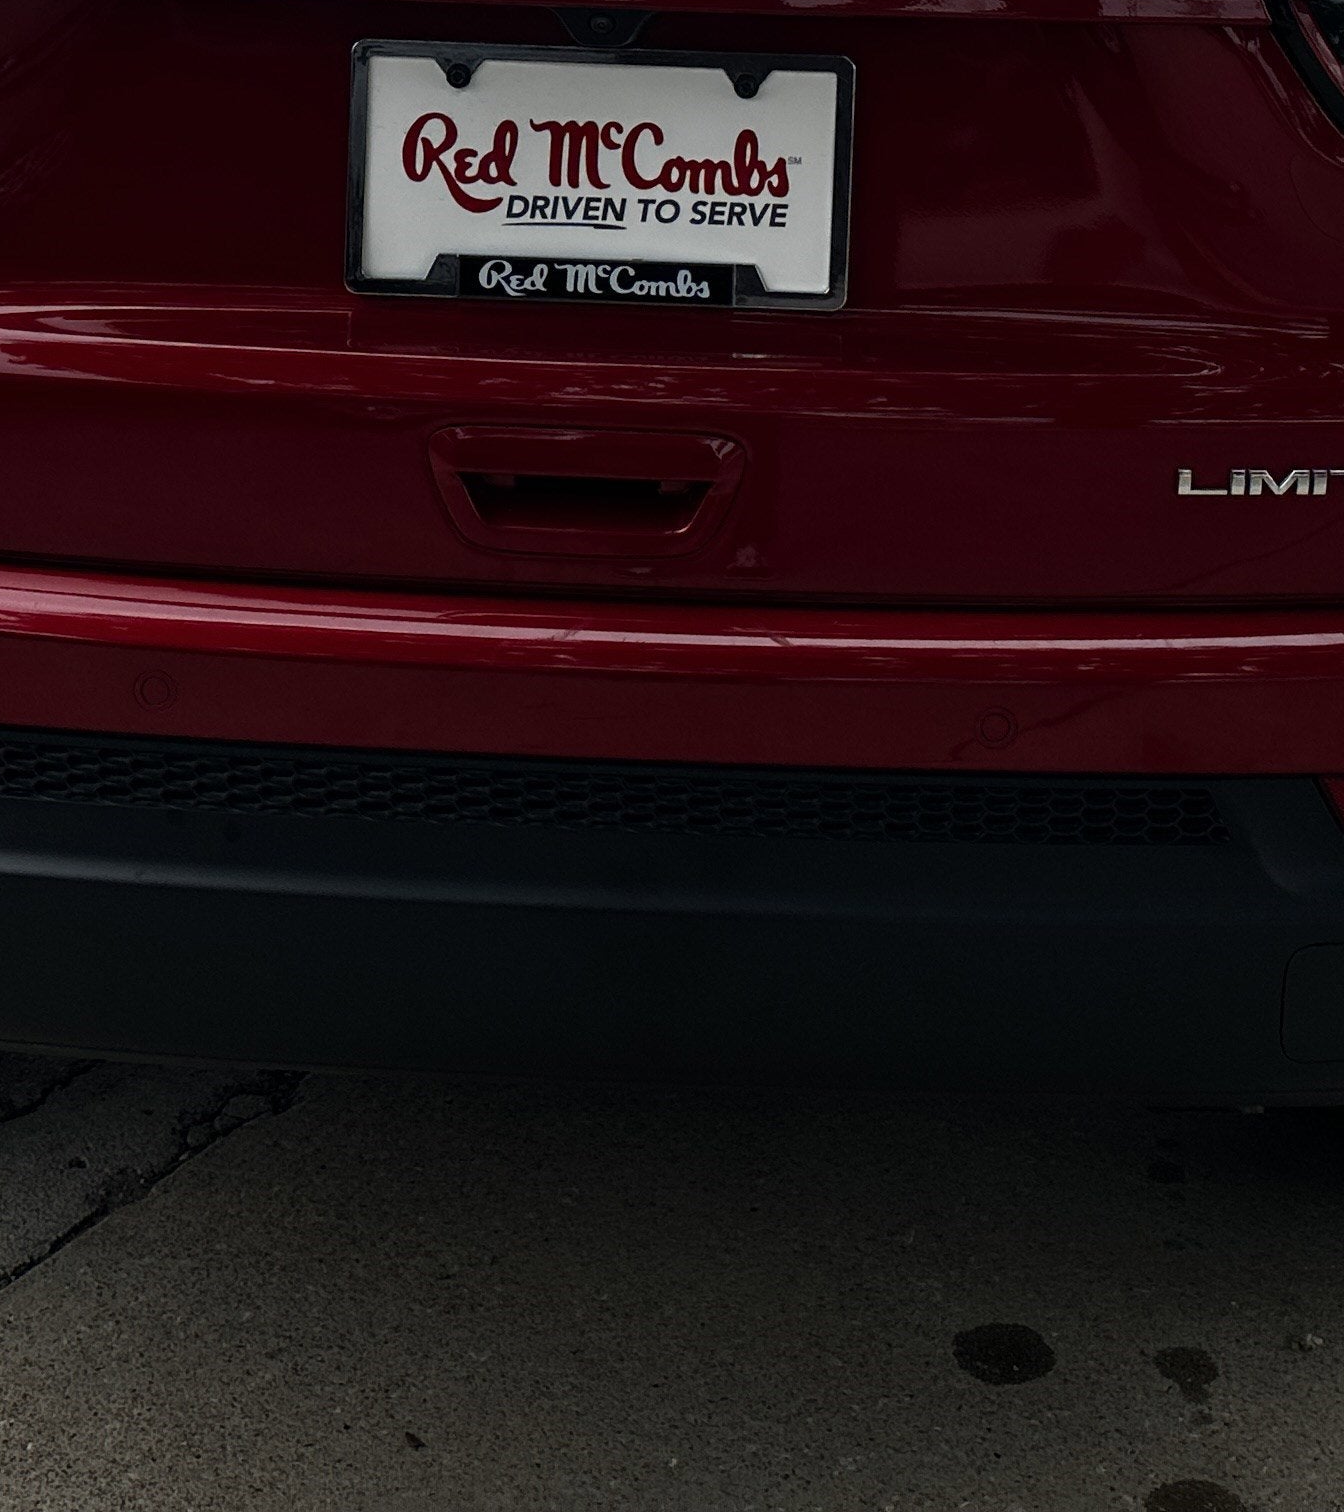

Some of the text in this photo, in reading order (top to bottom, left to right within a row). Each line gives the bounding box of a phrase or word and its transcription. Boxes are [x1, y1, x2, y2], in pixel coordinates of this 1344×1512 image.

[401, 112, 520, 214] Red
[529, 118, 790, 198] McCombs
[506, 195, 790, 229] DRIVEN TO SERVE
[478, 259, 711, 300] Red McCombs
